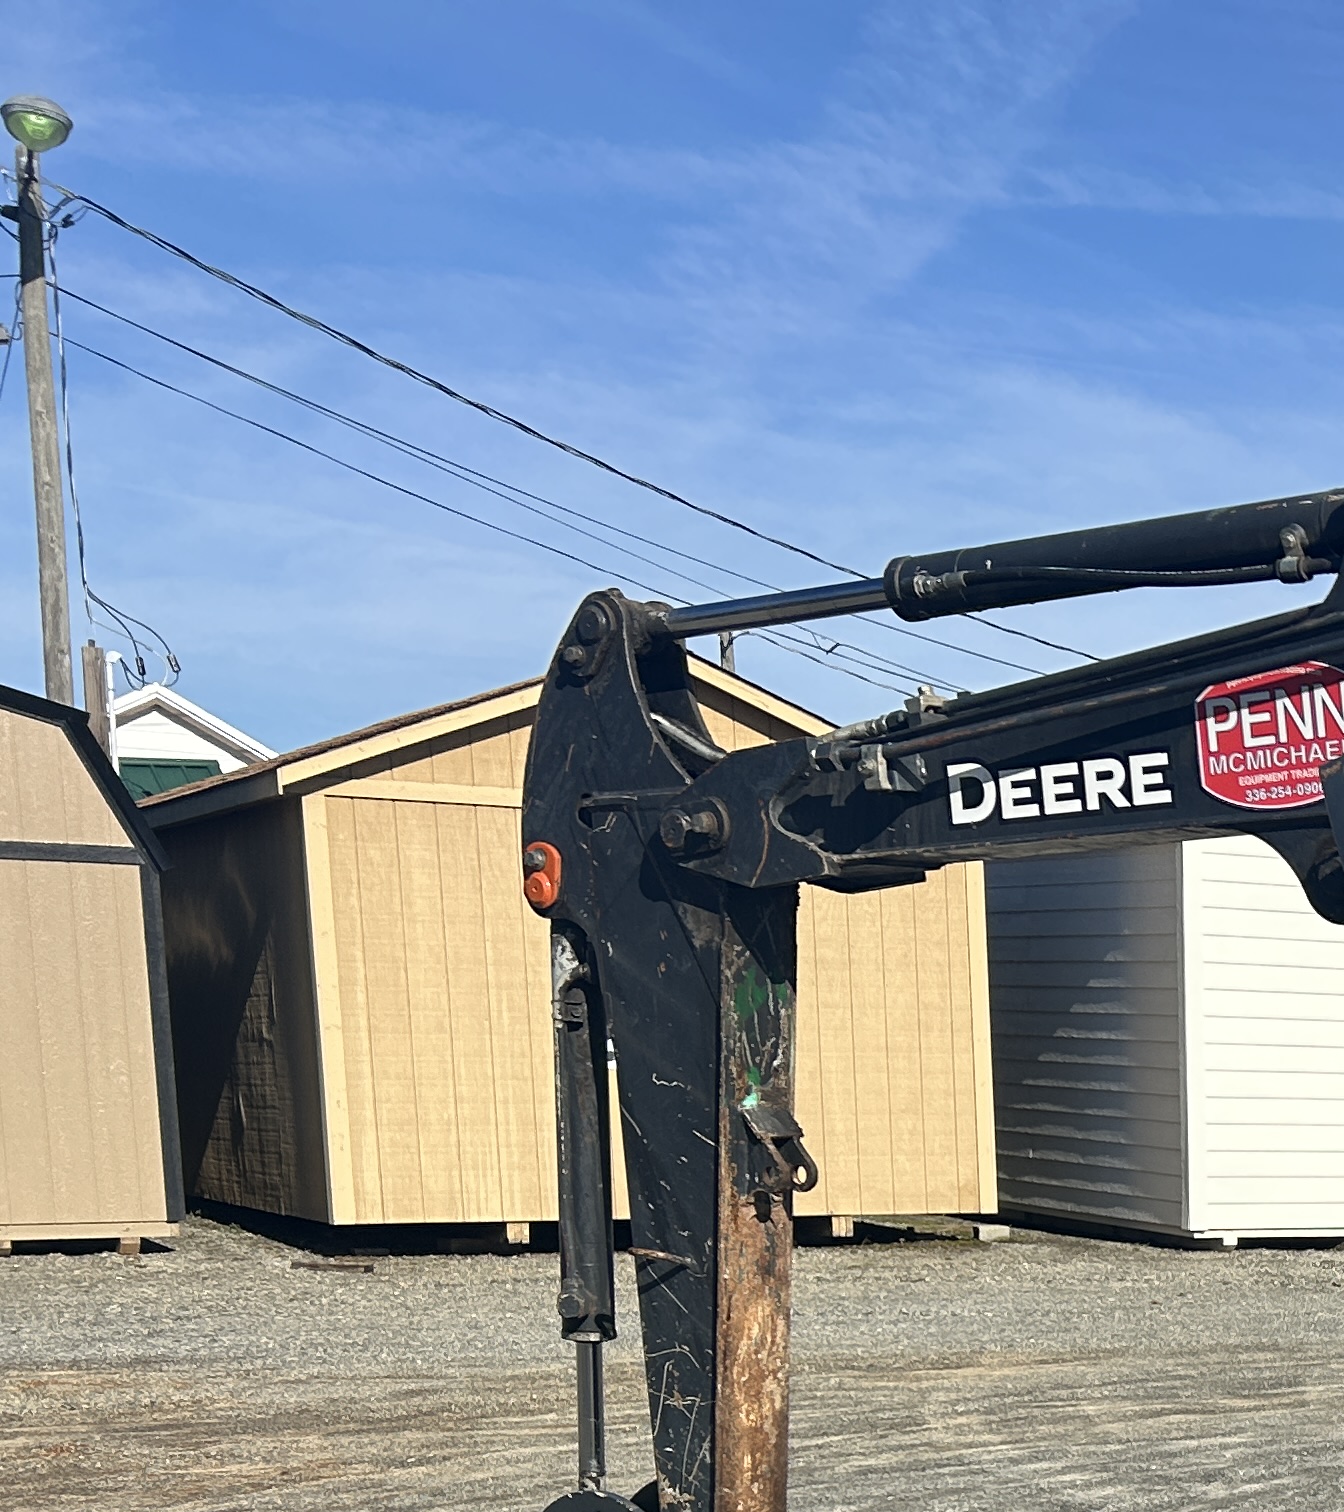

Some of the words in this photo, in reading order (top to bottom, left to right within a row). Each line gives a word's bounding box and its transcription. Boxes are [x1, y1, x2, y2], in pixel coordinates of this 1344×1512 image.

[946, 752, 1173, 825] DEERE
[1238, 771, 1290, 787] EQUIPMENT
[1290, 765, 1320, 779] TRADI
